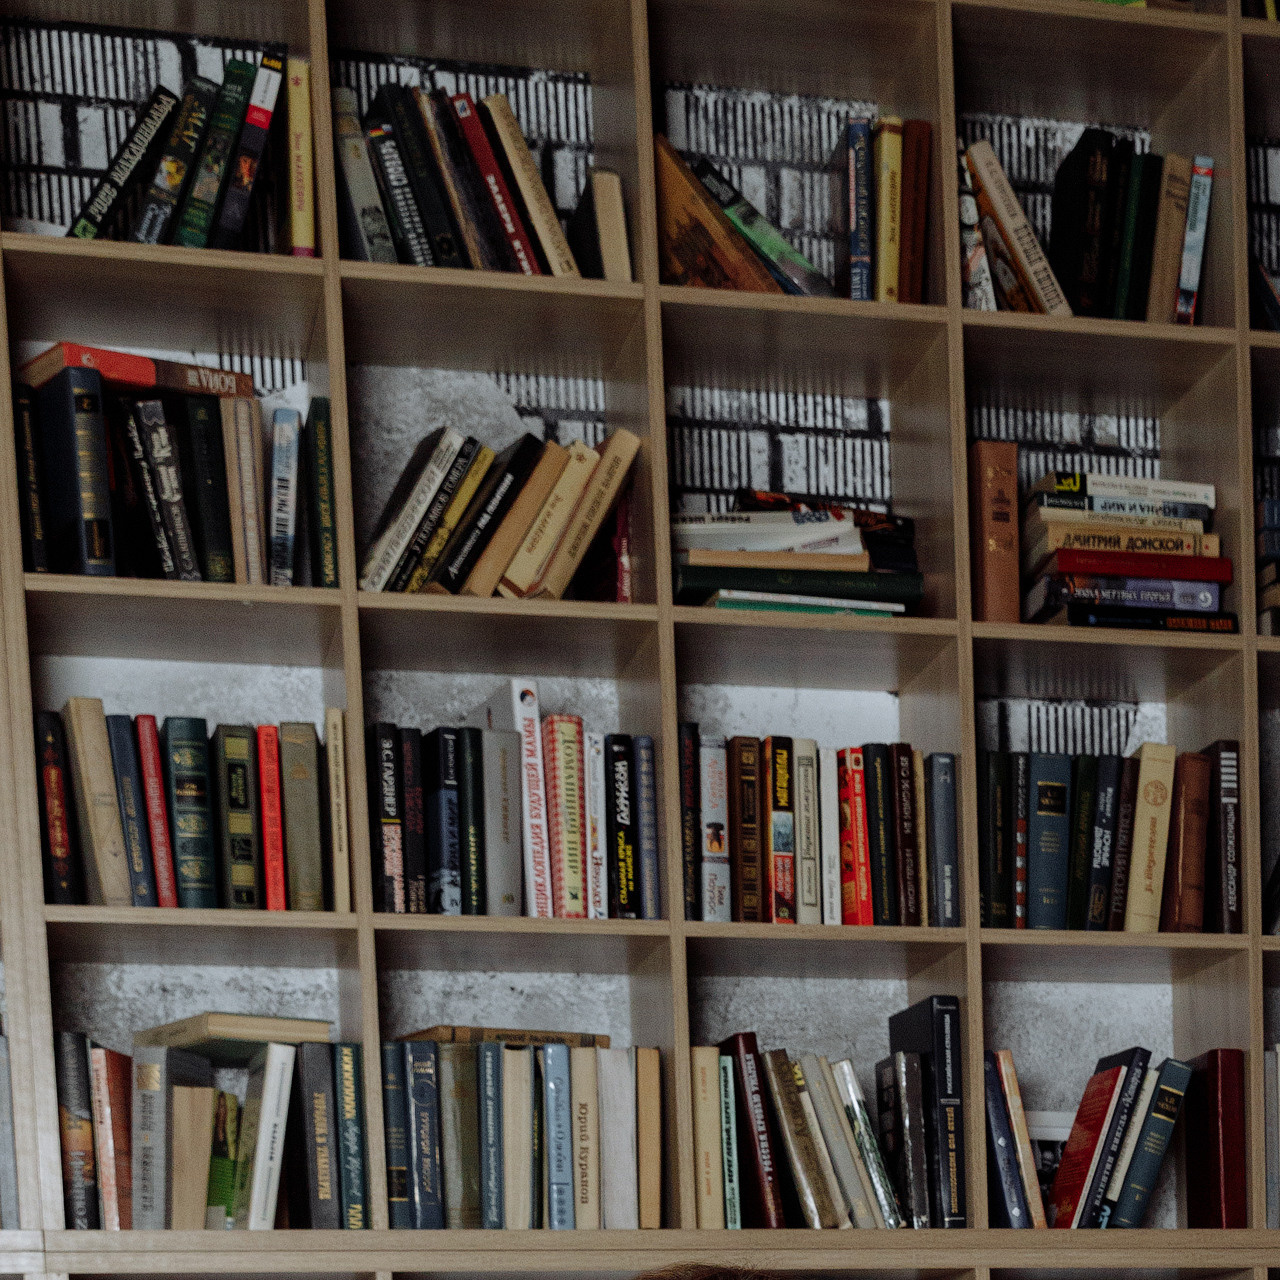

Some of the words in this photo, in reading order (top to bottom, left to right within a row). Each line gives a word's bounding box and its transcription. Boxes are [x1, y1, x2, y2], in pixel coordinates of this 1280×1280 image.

[86, 181, 119, 223] РОСС
[108, 89, 178, 189] МАКДОНАЛЬД
[378, 137, 408, 187] СЛОВАРЬ
[1100, 501, 1125, 511] МИР
[1126, 504, 1135, 512] И
[1137, 503, 1177, 516] ВОЙНА
[1062, 533, 1120, 550] ДМИТРИЙ
[1126, 536, 1183, 553] ДОНСКОЙ
[522, 716, 537, 760] МАМЫ
[526, 762, 543, 820] БУДУЩЕЙ
[616, 830, 626, 858] КРЫСА
[1226, 804, 1236, 861] СОЛЖЕНИЦЫН
[618, 861, 628, 903] СТАЛЬНАЯ
[1228, 863, 1237, 911] АЛЕКСАНДР
[577, 1102, 589, 1141] Юрий
[752, 1092, 766, 1131] КРОВЬЮ
[946, 1106, 954, 1130] ДЕТЕЙ
[577, 1147, 590, 1204] Куранов
[726, 1158, 734, 1182] БЕРЕГ
[1093, 1154, 1116, 1206] ВАЛЕНТИН
[1110, 1113, 1129, 1151] ПИКУЛЬ
[948, 1151, 958, 1212] ЭНЦИКЛОПЕДИЯ
